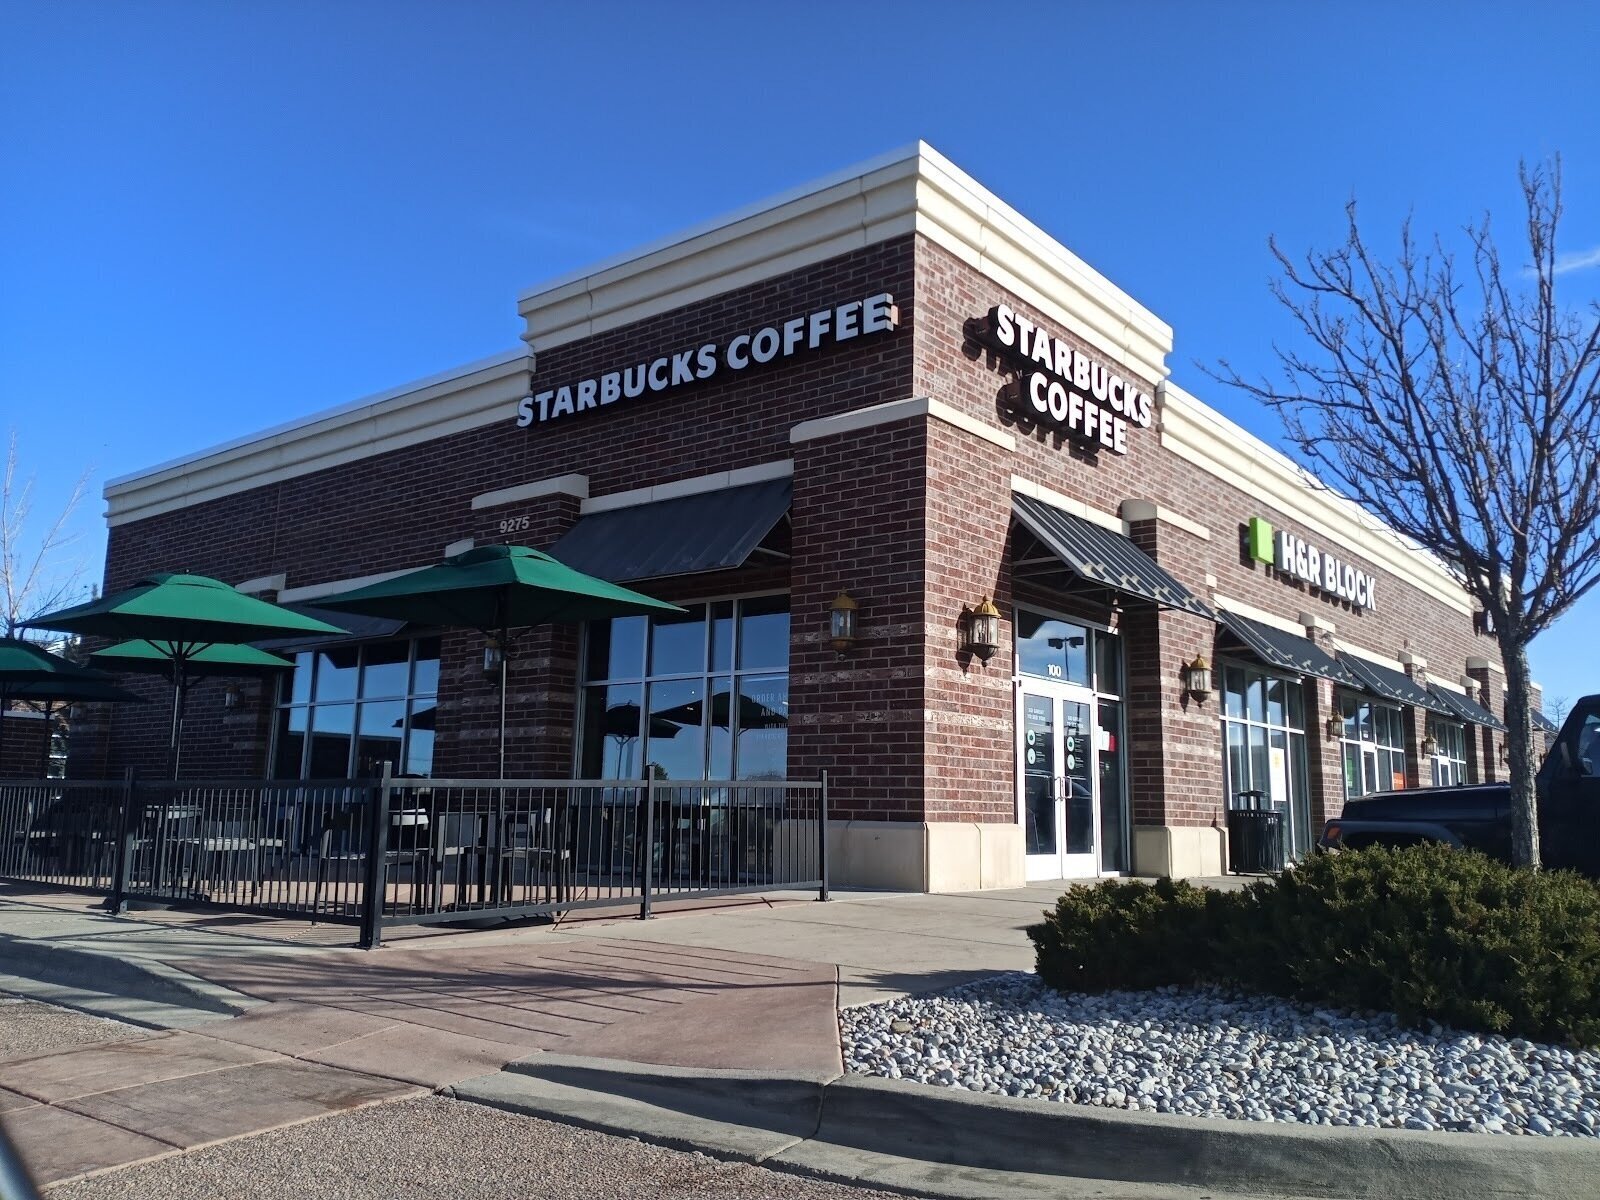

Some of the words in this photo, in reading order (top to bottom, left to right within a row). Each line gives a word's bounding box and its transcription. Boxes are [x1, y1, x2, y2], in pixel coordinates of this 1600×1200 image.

[516, 343, 717, 428] STARBUCKS
[726, 293, 894, 370] COFFEE
[996, 303, 1152, 428] STARBUCKS
[1030, 371, 1127, 455] COFFEE
[500, 516, 530, 533] 9275
[1281, 530, 1321, 586] H&R
[1324, 553, 1376, 611] BLOCK
[1047, 663, 1062, 677] 100
[760, 707, 776, 717] AND
